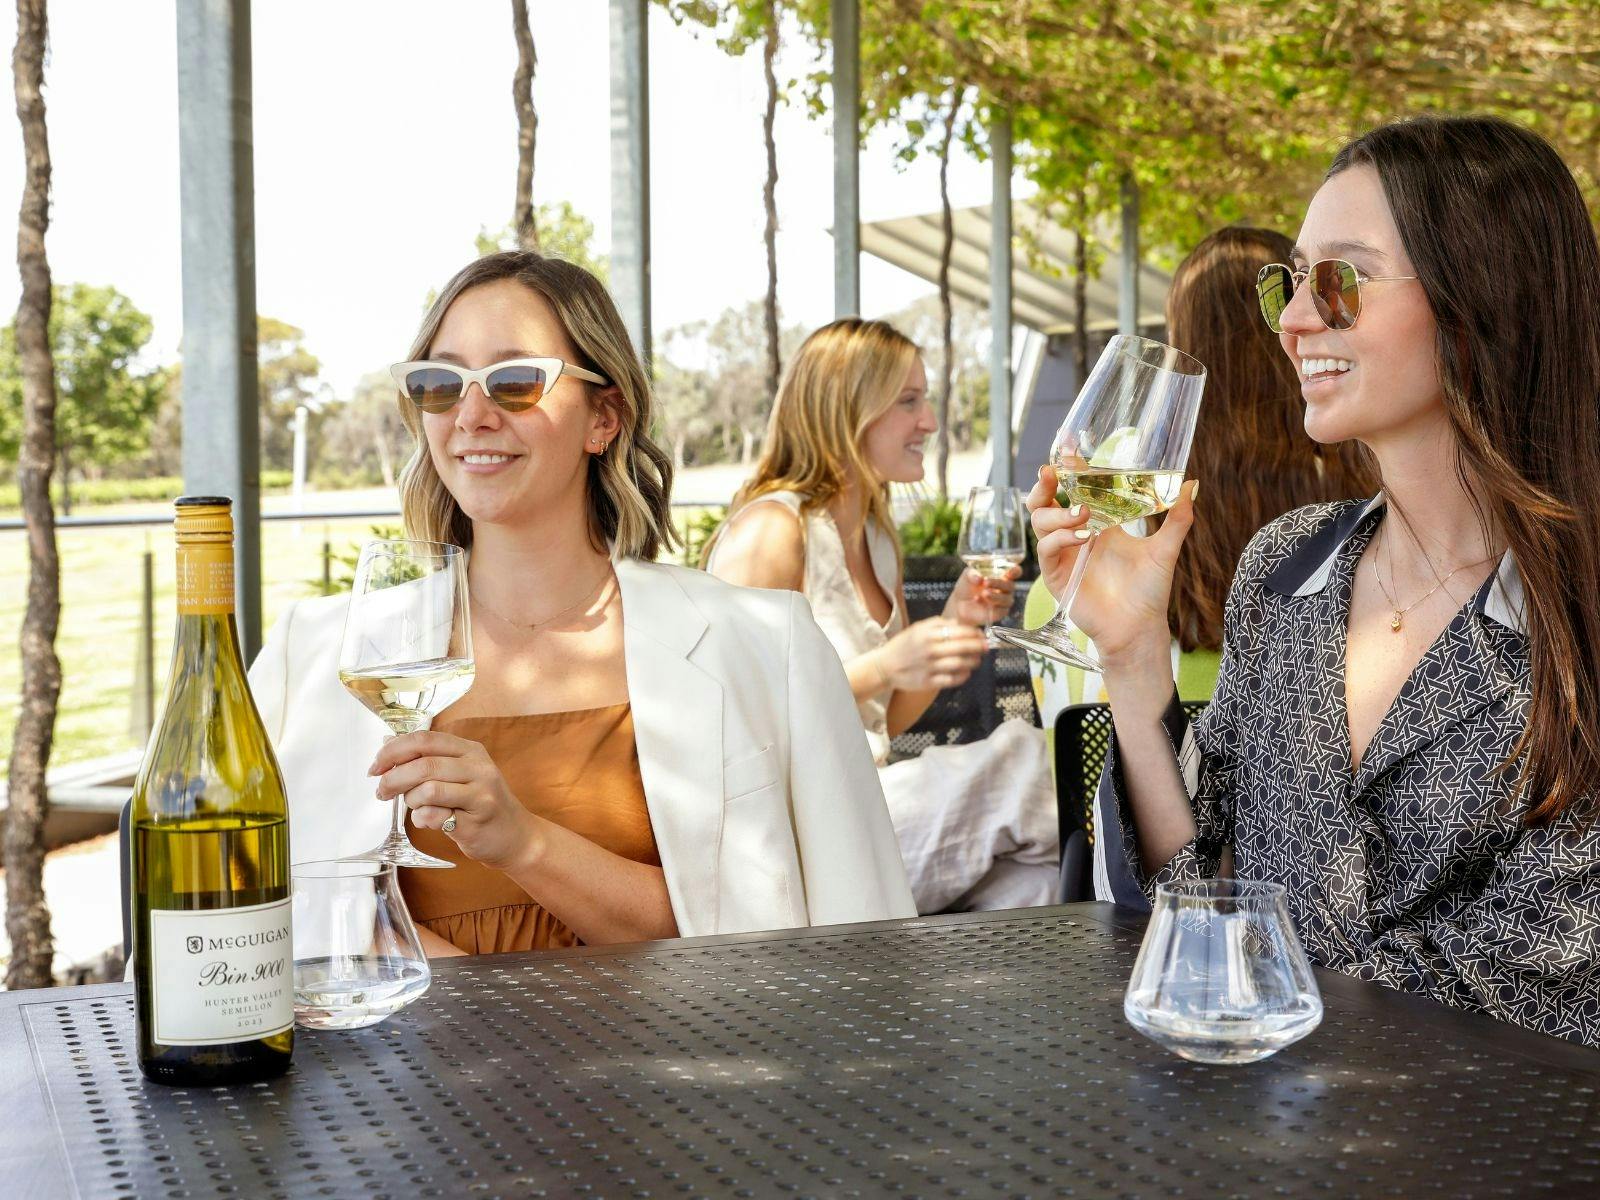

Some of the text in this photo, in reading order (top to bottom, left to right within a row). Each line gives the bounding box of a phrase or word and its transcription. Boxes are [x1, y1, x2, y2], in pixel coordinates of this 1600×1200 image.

[208, 926, 289, 950] McGUIGAN
[198, 958, 285, 987] Bin 9000
[204, 996, 250, 1008] HUNTER
[221, 1001, 273, 1016] SEMILLON
